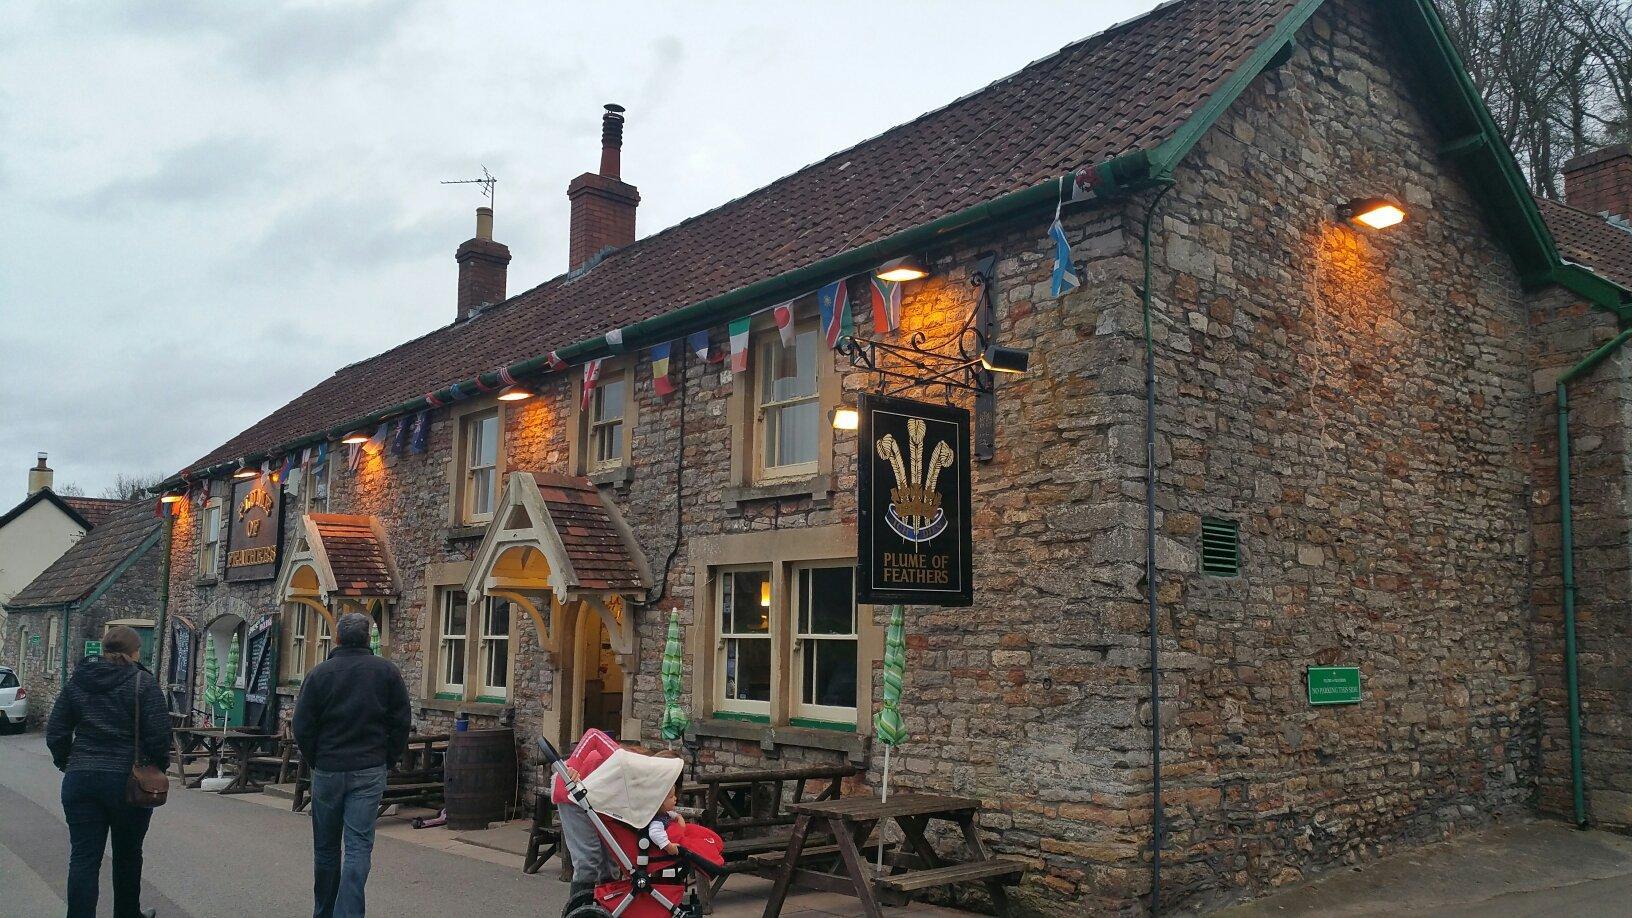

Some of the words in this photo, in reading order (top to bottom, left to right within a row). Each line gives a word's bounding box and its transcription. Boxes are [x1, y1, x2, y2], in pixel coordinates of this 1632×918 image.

[247, 519, 261, 538] OF
[226, 544, 277, 569] FEATHERS
[883, 552, 927, 568] PLUME
[931, 554, 949, 569] OF
[883, 567, 949, 584] FEATHERS
